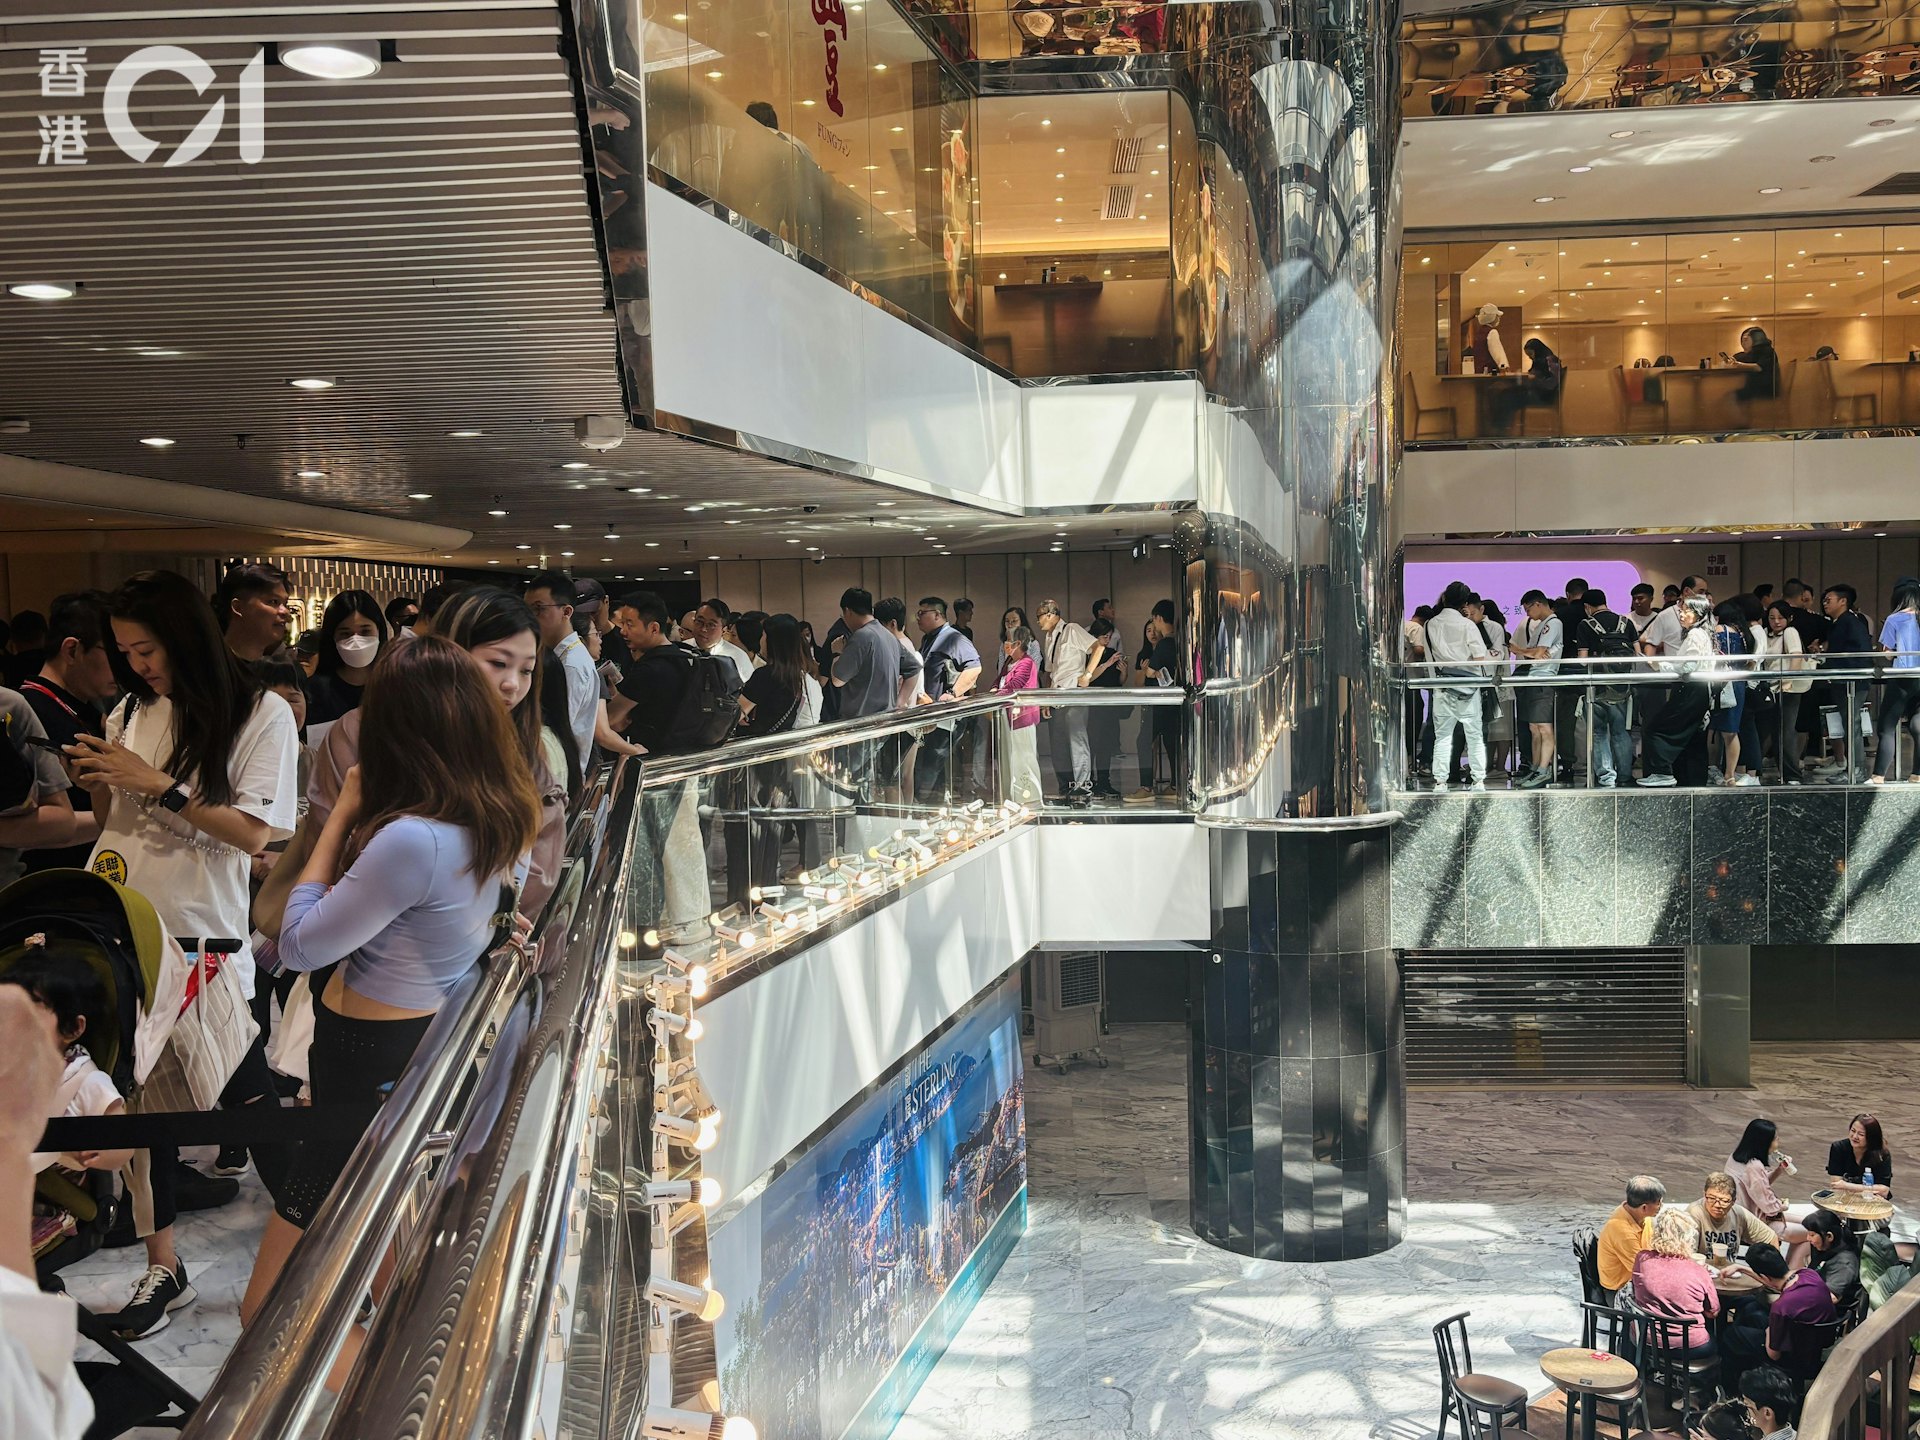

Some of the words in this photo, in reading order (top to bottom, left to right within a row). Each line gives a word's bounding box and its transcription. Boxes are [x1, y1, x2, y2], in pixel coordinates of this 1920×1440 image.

[94, 856, 119, 873] 美聯
[912, 1046, 931, 1081] THE
[912, 1053, 957, 1114] STERLING
[286, 1206, 302, 1219] alo
